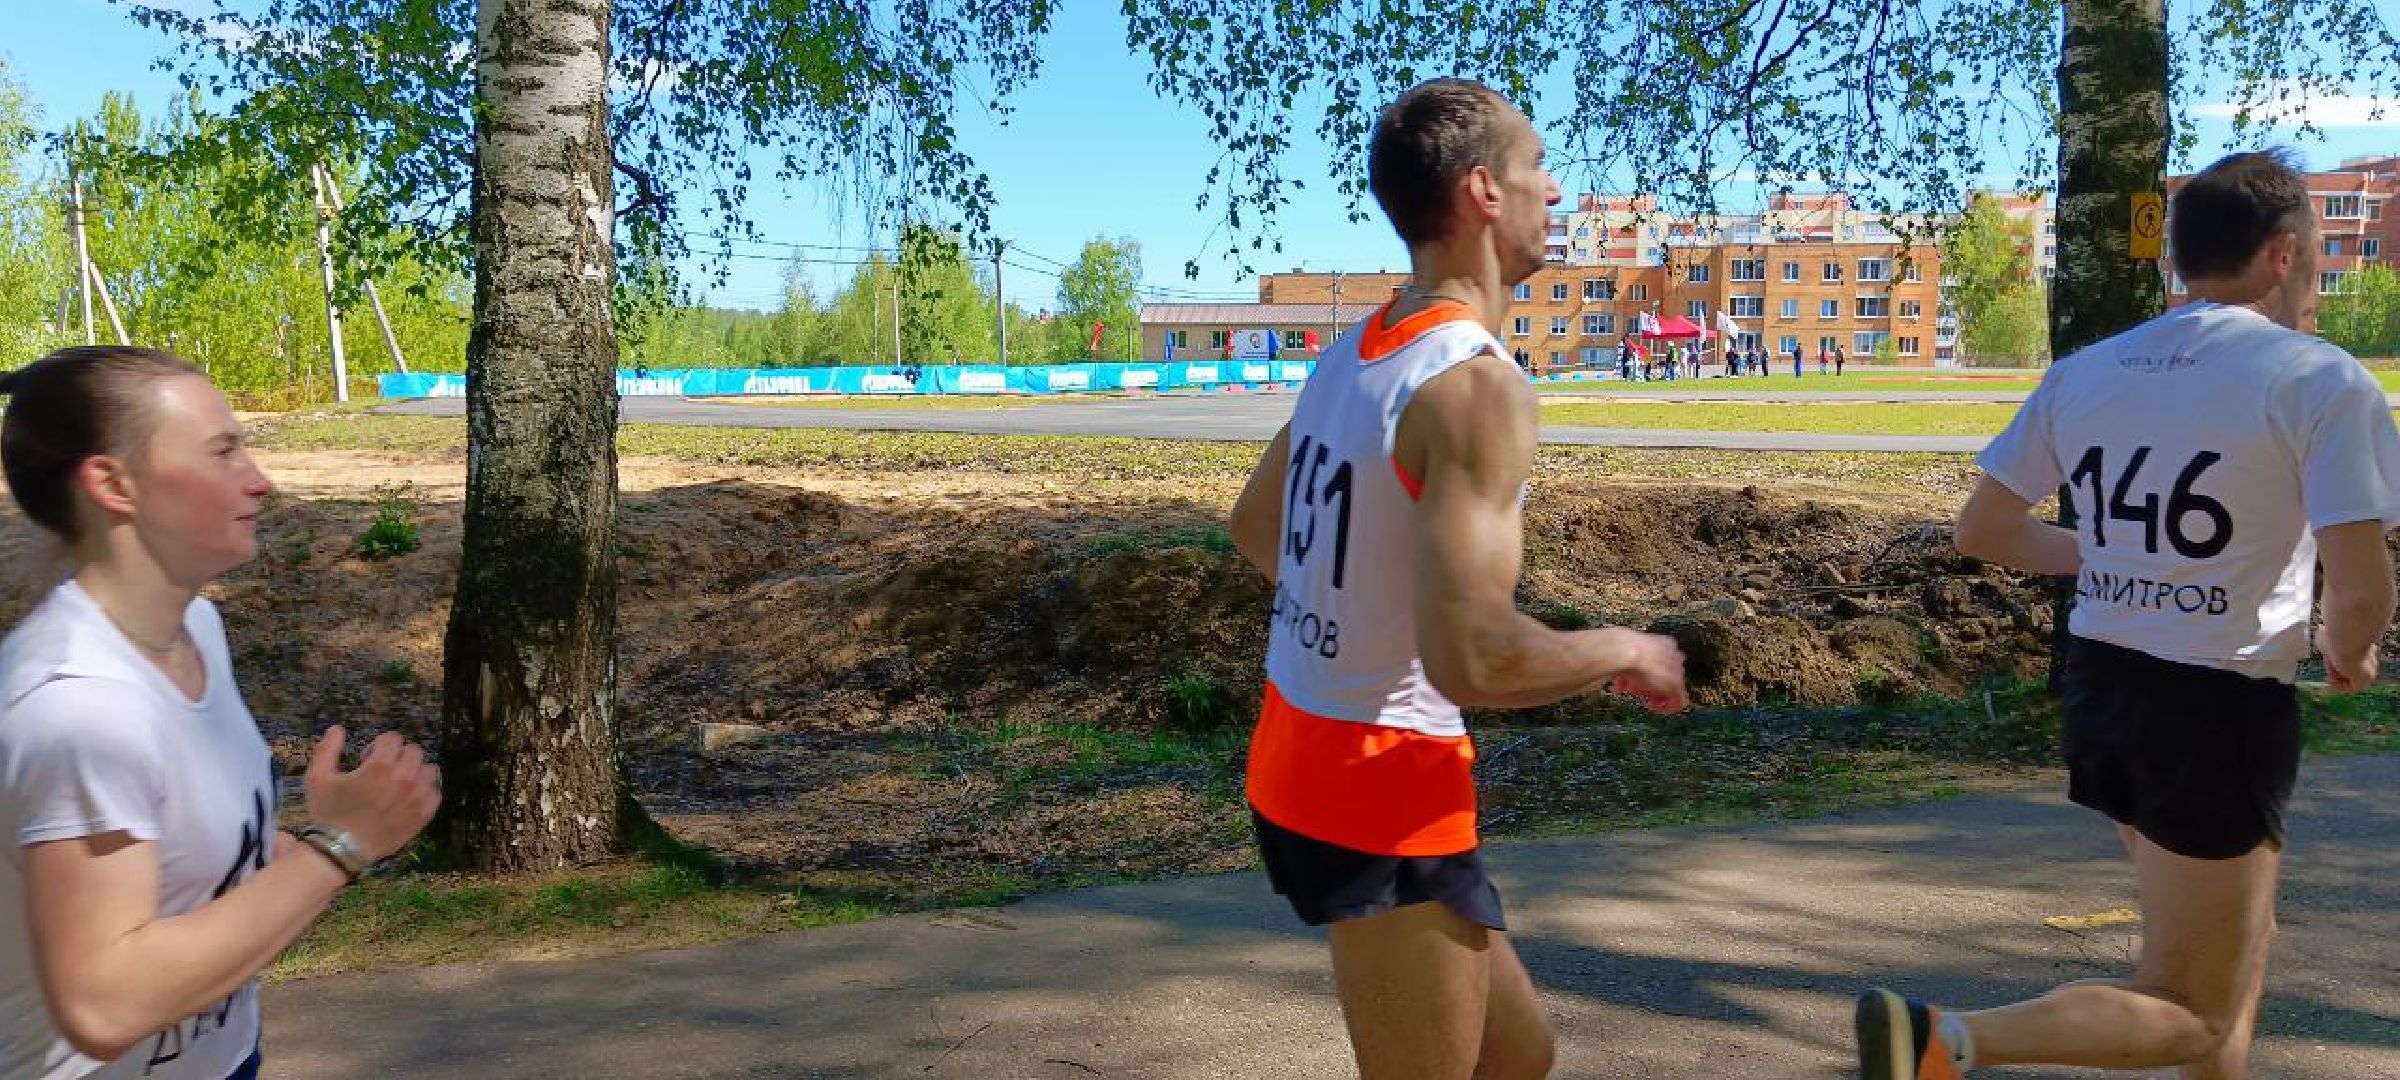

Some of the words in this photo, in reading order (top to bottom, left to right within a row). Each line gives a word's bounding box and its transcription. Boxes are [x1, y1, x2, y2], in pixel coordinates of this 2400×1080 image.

[1286, 434, 1353, 590] 151
[2070, 445, 2234, 559] 146
[2076, 569, 2229, 616] МИТРОВ
